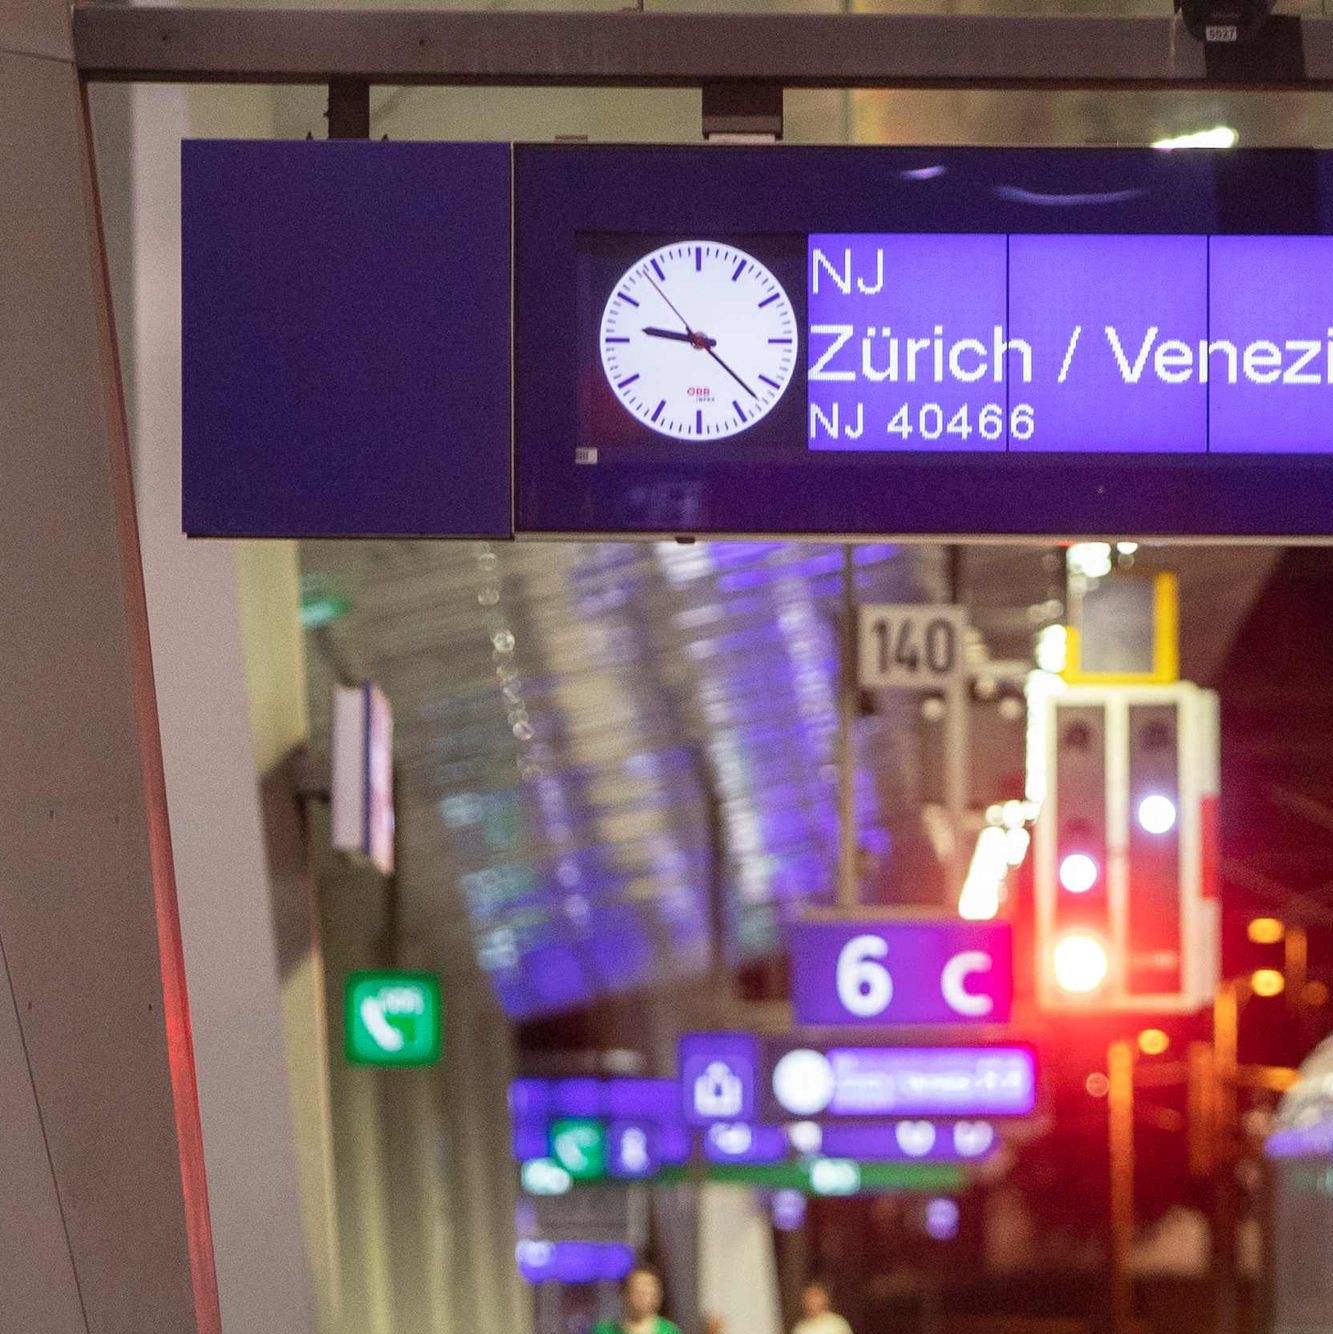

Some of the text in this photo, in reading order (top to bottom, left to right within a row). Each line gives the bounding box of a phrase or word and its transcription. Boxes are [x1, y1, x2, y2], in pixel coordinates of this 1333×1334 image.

[811, 248, 884, 296] NJ
[808, 323, 1033, 383] Zürich
[1056, 326, 1083, 384] /
[809, 402, 1035, 441] NJ 40466
[871, 618, 956, 673] 140
[835, 934, 894, 1017] 6
